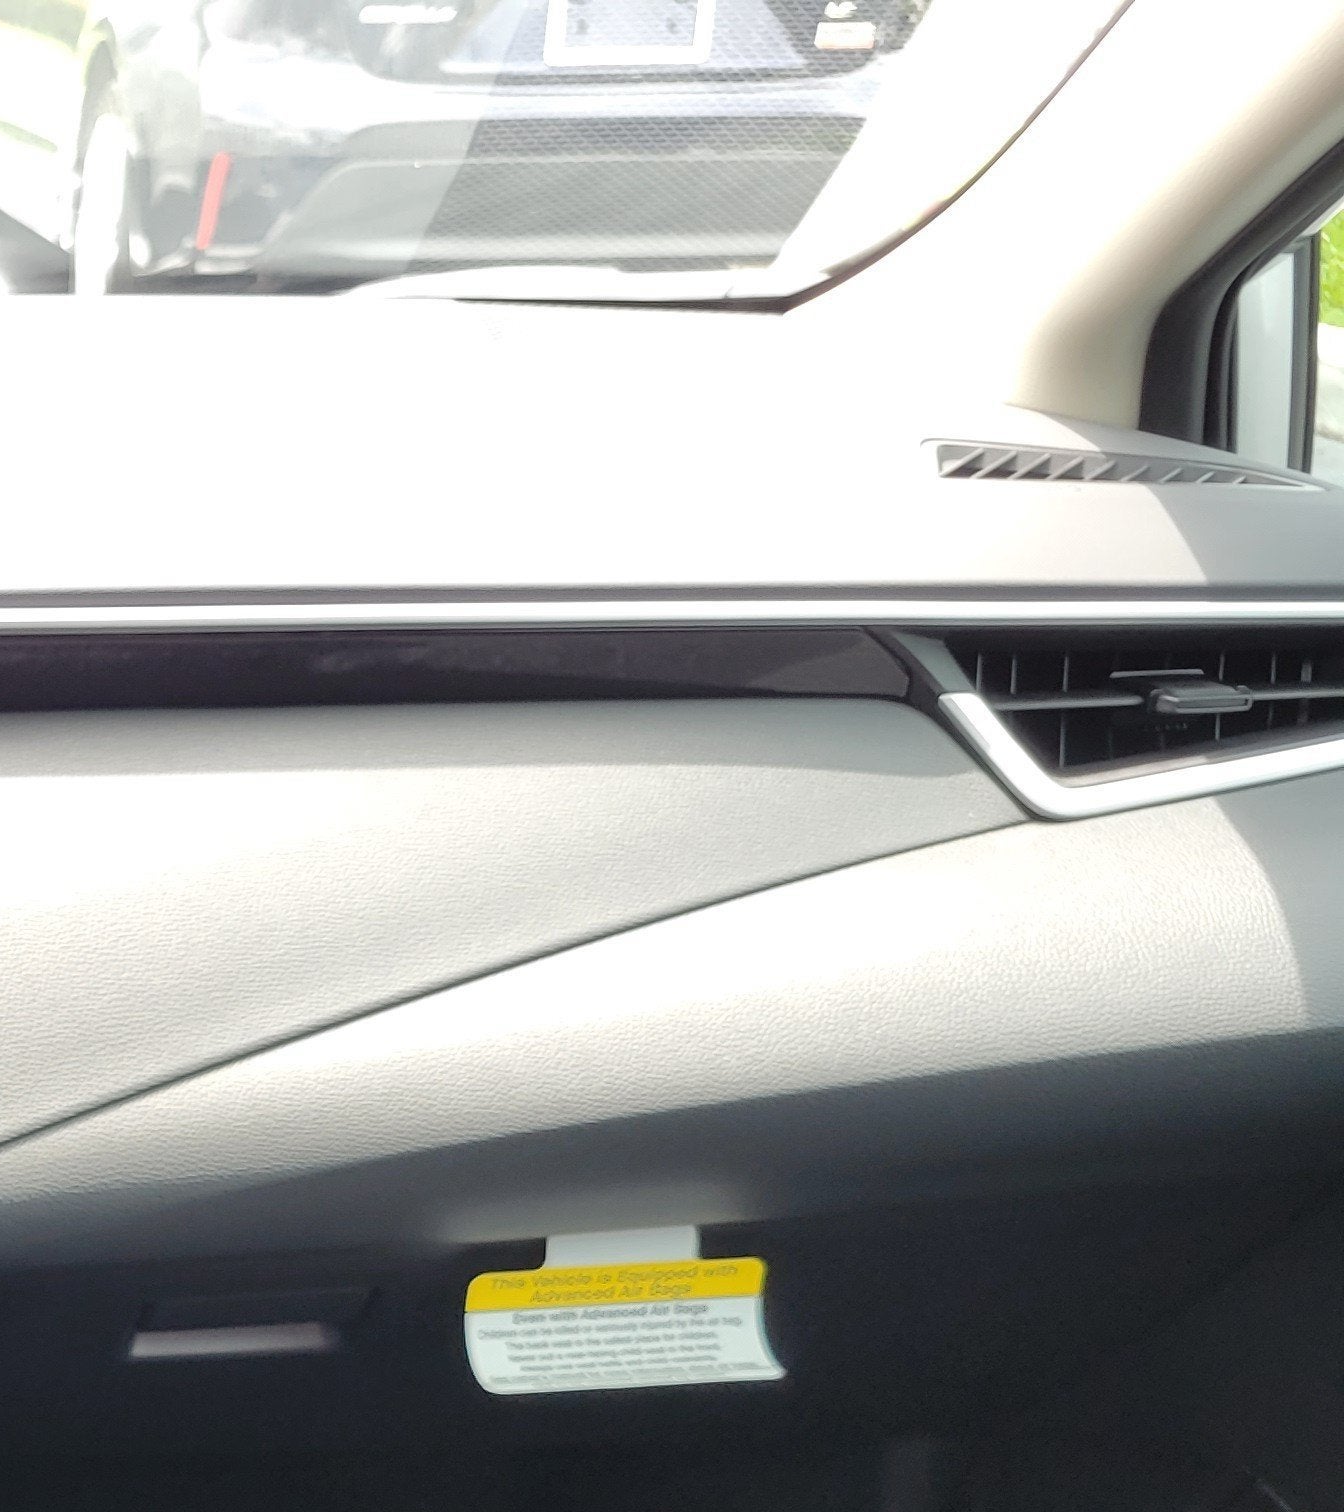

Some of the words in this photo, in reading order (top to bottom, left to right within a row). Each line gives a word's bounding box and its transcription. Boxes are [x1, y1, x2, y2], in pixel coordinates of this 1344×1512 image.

[532, 1273, 591, 1288] Vehicle
[617, 1266, 699, 1284] Equipped
[530, 1287, 616, 1303] Advanced
[618, 1285, 644, 1298] Air
[650, 1282, 692, 1299] Bags
[580, 1306, 648, 1321] Advanced
